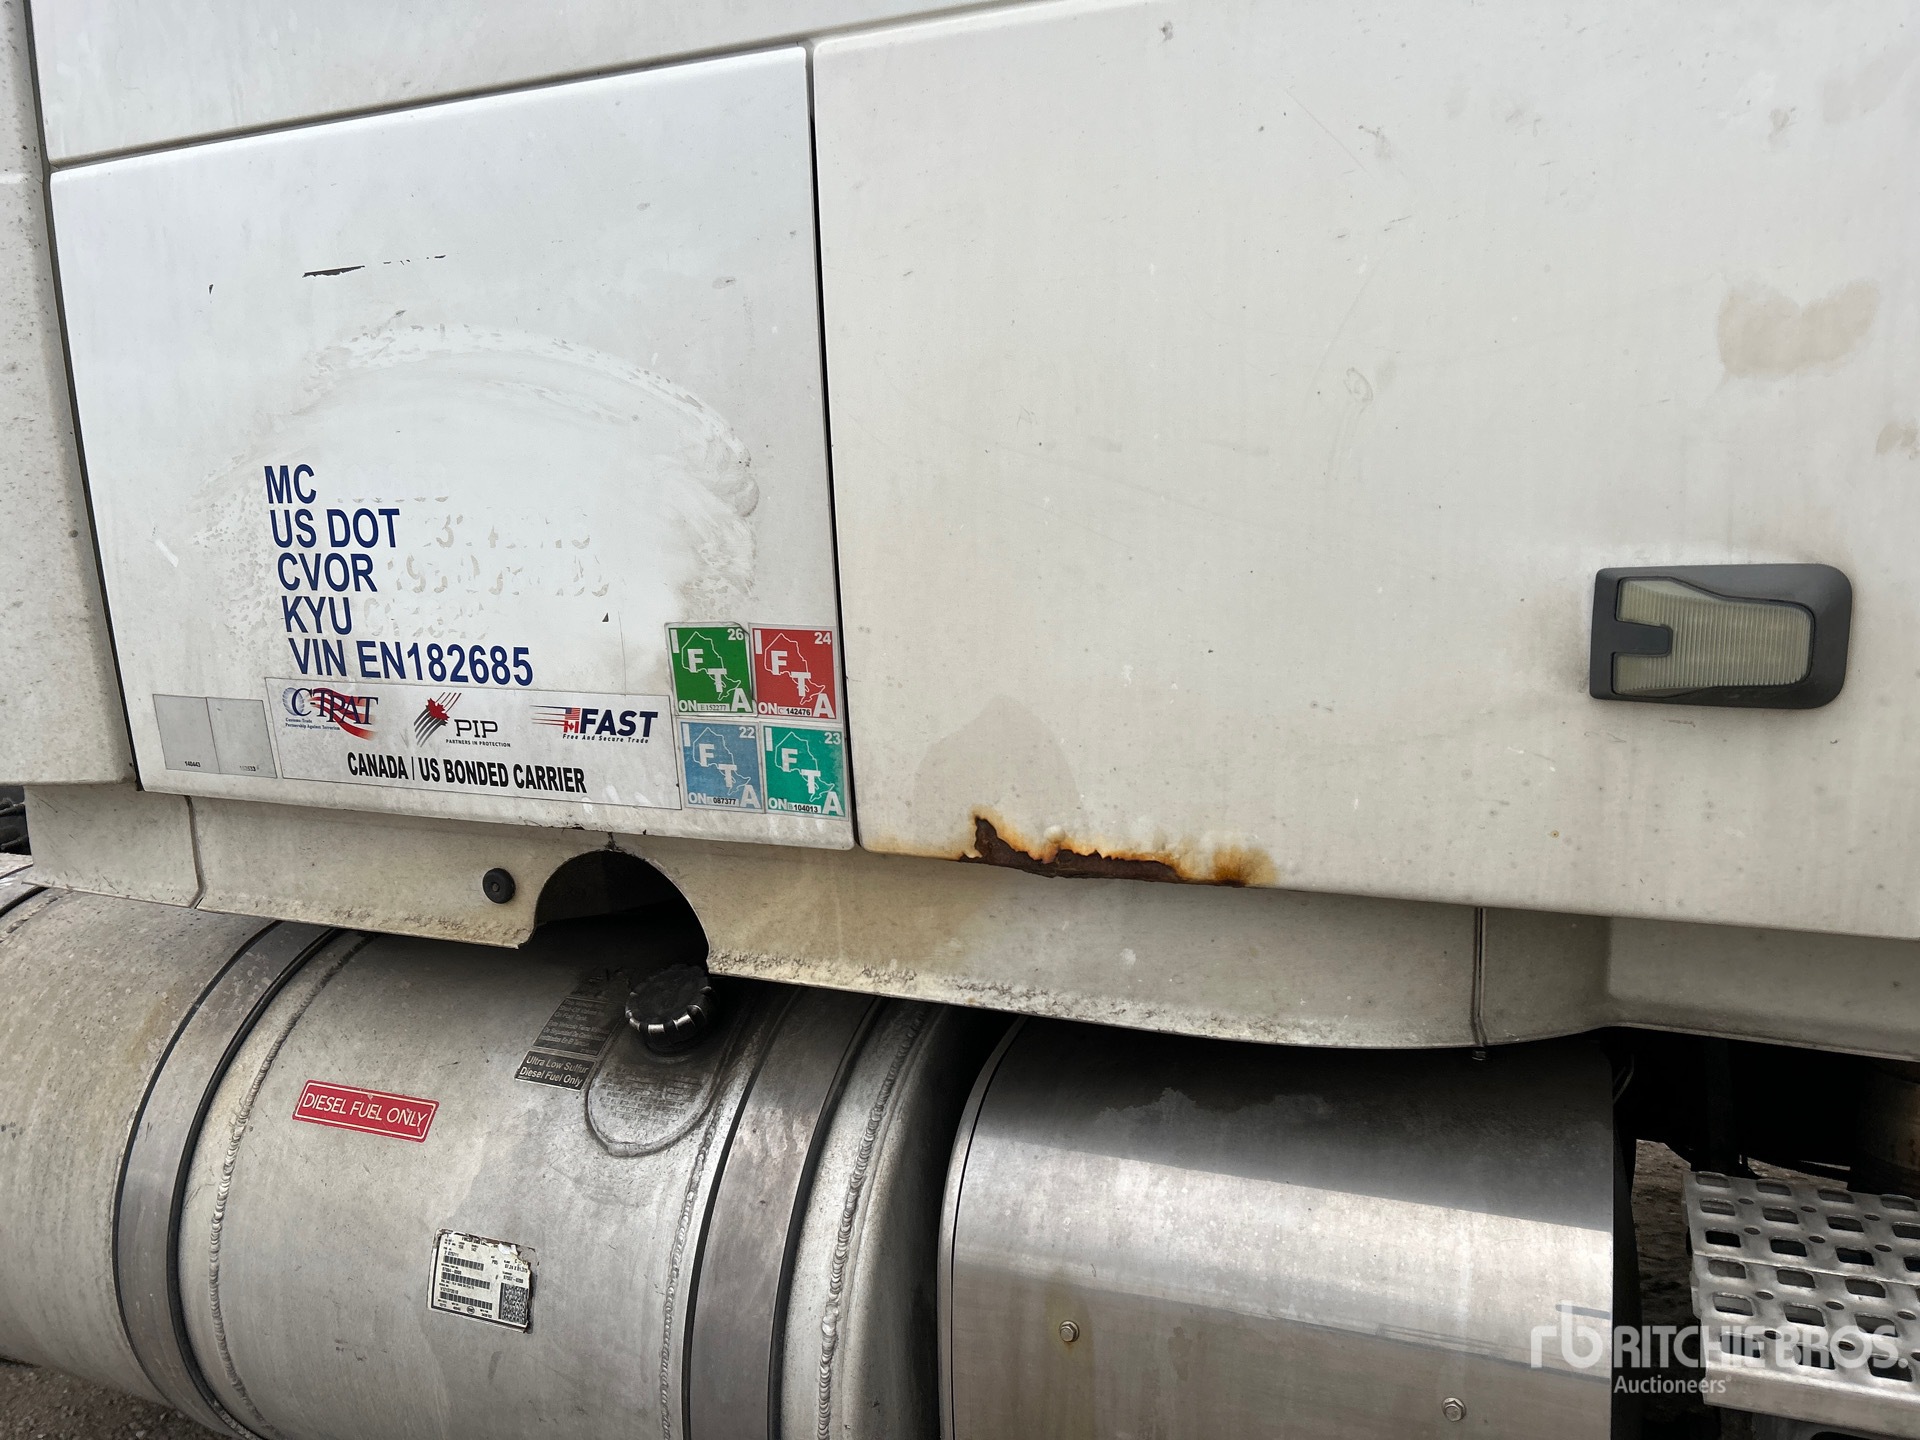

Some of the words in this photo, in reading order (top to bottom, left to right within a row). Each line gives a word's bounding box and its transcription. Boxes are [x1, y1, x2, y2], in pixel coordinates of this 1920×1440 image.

[265, 464, 317, 504] MC
[270, 509, 317, 549] US
[327, 508, 400, 548] DOT
[277, 552, 378, 592] CVOR
[281, 596, 352, 635] KYU
[727, 629, 744, 641] 26
[814, 632, 831, 645] 24
[288, 638, 347, 677] VIN
[357, 640, 533, 686] EN182685
[679, 700, 696, 711] ON
[759, 702, 778, 714] ON
[454, 719, 498, 738] PIP
[580, 708, 658, 737] FAST
[739, 727, 755, 739] 22
[824, 732, 841, 744] 23
[347, 752, 409, 780] CANADA
[418, 757, 440, 782] US
[443, 758, 509, 788] BONDED
[513, 763, 587, 794] CARRIER
[688, 792, 707, 804] ON
[769, 797, 787, 810] ON
[794, 804, 818, 813] 104013
[526, 1056, 545, 1066] Ultra
[546, 1059, 564, 1069] Low
[563, 1062, 589, 1074] Sulfur
[519, 1066, 545, 1079] Diesel
[544, 1071, 564, 1082] Fuel
[563, 1074, 583, 1088] Only
[302, 1093, 347, 1115] DIESEL
[349, 1101, 383, 1121] FUEL
[386, 1107, 428, 1128] ONLY
